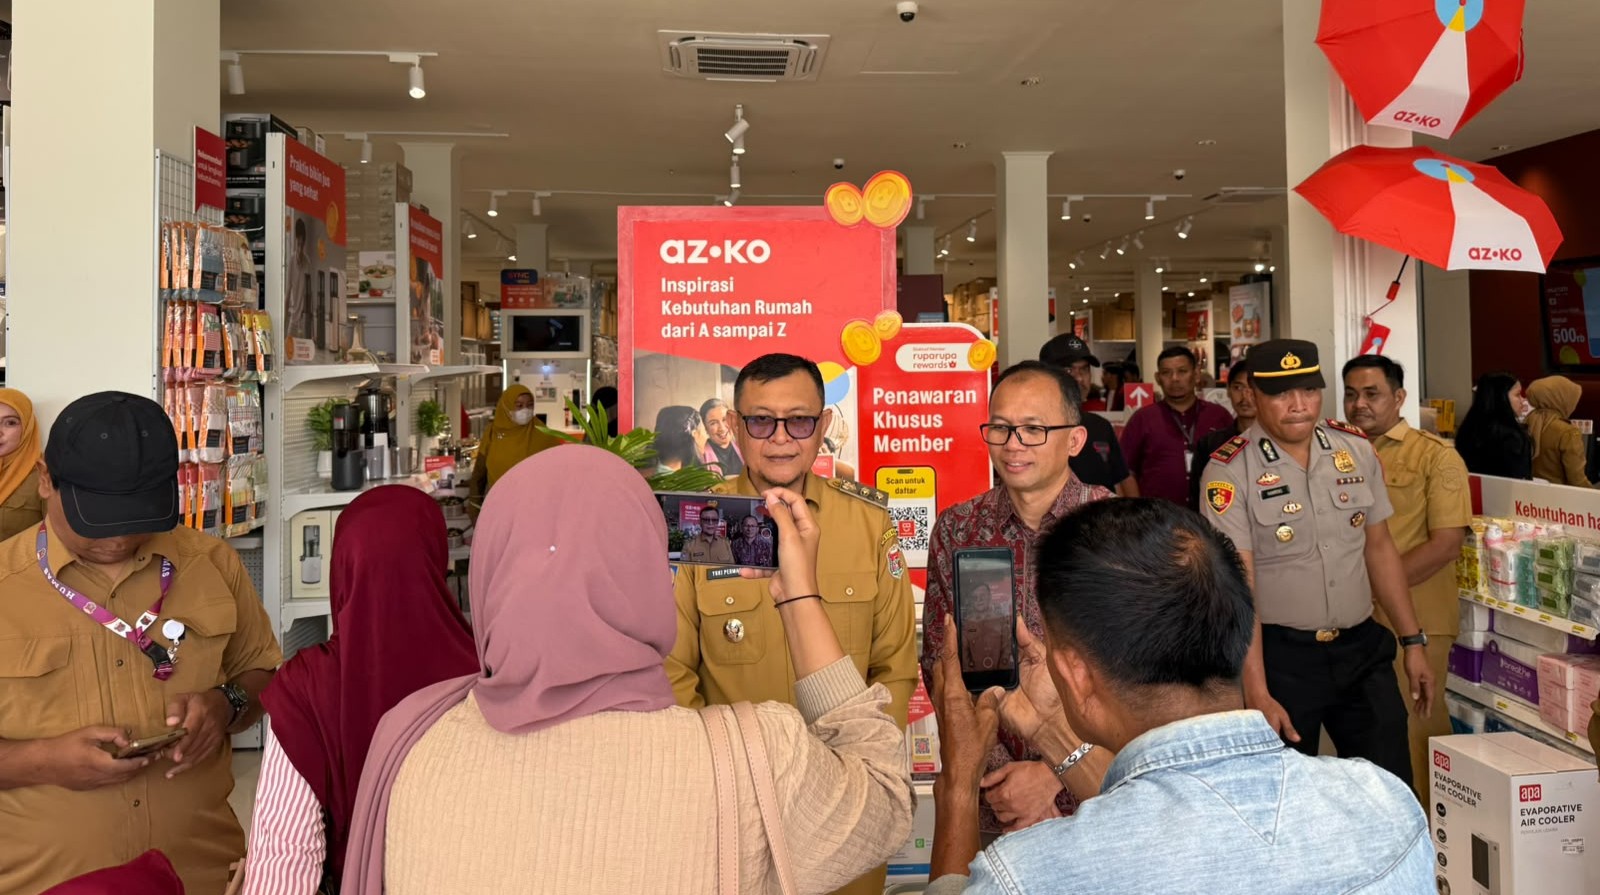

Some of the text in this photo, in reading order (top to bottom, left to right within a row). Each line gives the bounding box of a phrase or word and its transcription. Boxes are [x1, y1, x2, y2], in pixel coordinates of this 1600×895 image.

[661, 276, 734, 295] Inspirasi
[661, 299, 813, 316] Kebutuhan Rumah
[661, 322, 787, 340] dari A sampai Z
[913, 352, 957, 361] ruparupa
[913, 361, 948, 369] rewards
[873, 387, 977, 405] Penawaran
[873, 411, 943, 428] Khusus
[873, 435, 953, 453] Member
[886, 477, 903, 485] Scan
[1515, 500, 1584, 527] Kebutuhan
[1434, 752, 1449, 769] apa
[1434, 770, 1482, 801] EVAPORATIVE
[1520, 786, 1541, 802] apa
[1434, 781, 1446, 793] AIR
[1447, 787, 1477, 808] COOLER
[1520, 803, 1583, 817] EVAPORATIVE
[1520, 815, 1576, 827] AIR COOLER
